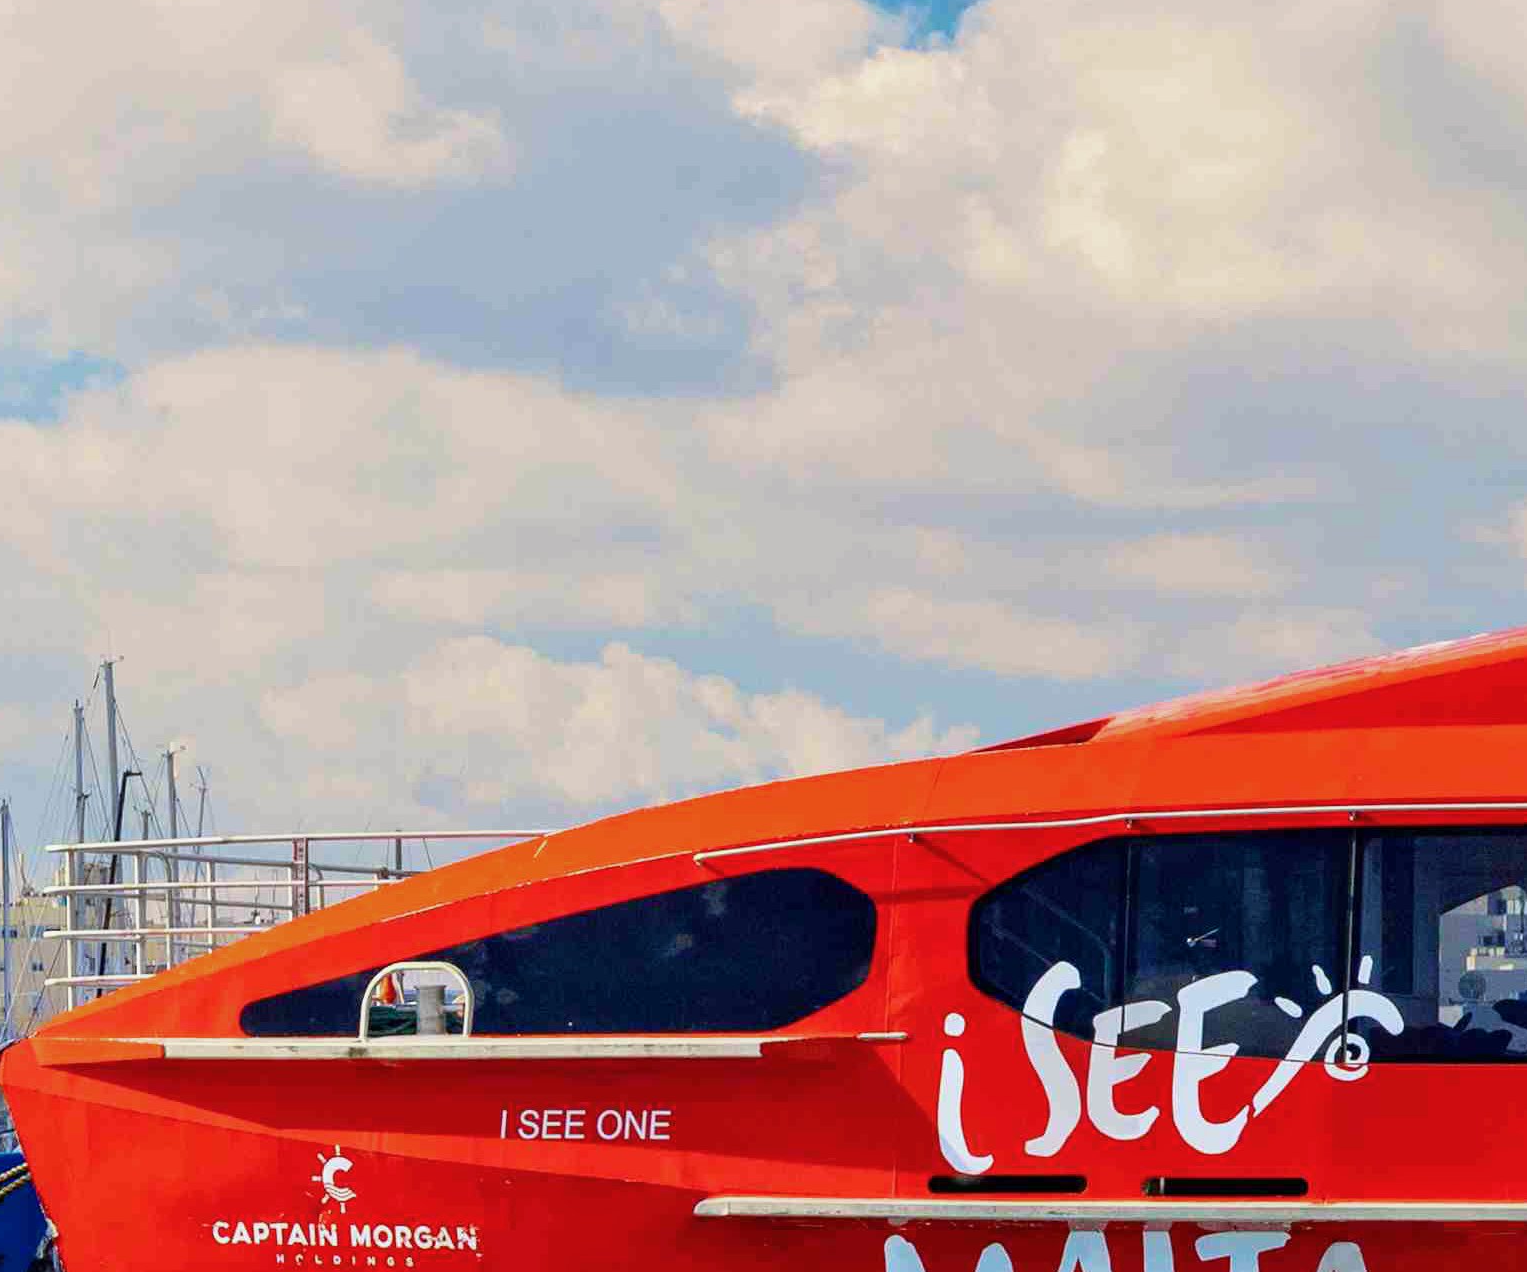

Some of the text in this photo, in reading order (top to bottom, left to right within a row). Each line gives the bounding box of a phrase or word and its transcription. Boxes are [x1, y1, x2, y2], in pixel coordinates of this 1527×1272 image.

[500, 1109, 672, 1140] I SEE ONE
[212, 1220, 478, 1251] CAPTAIN MORGAN
